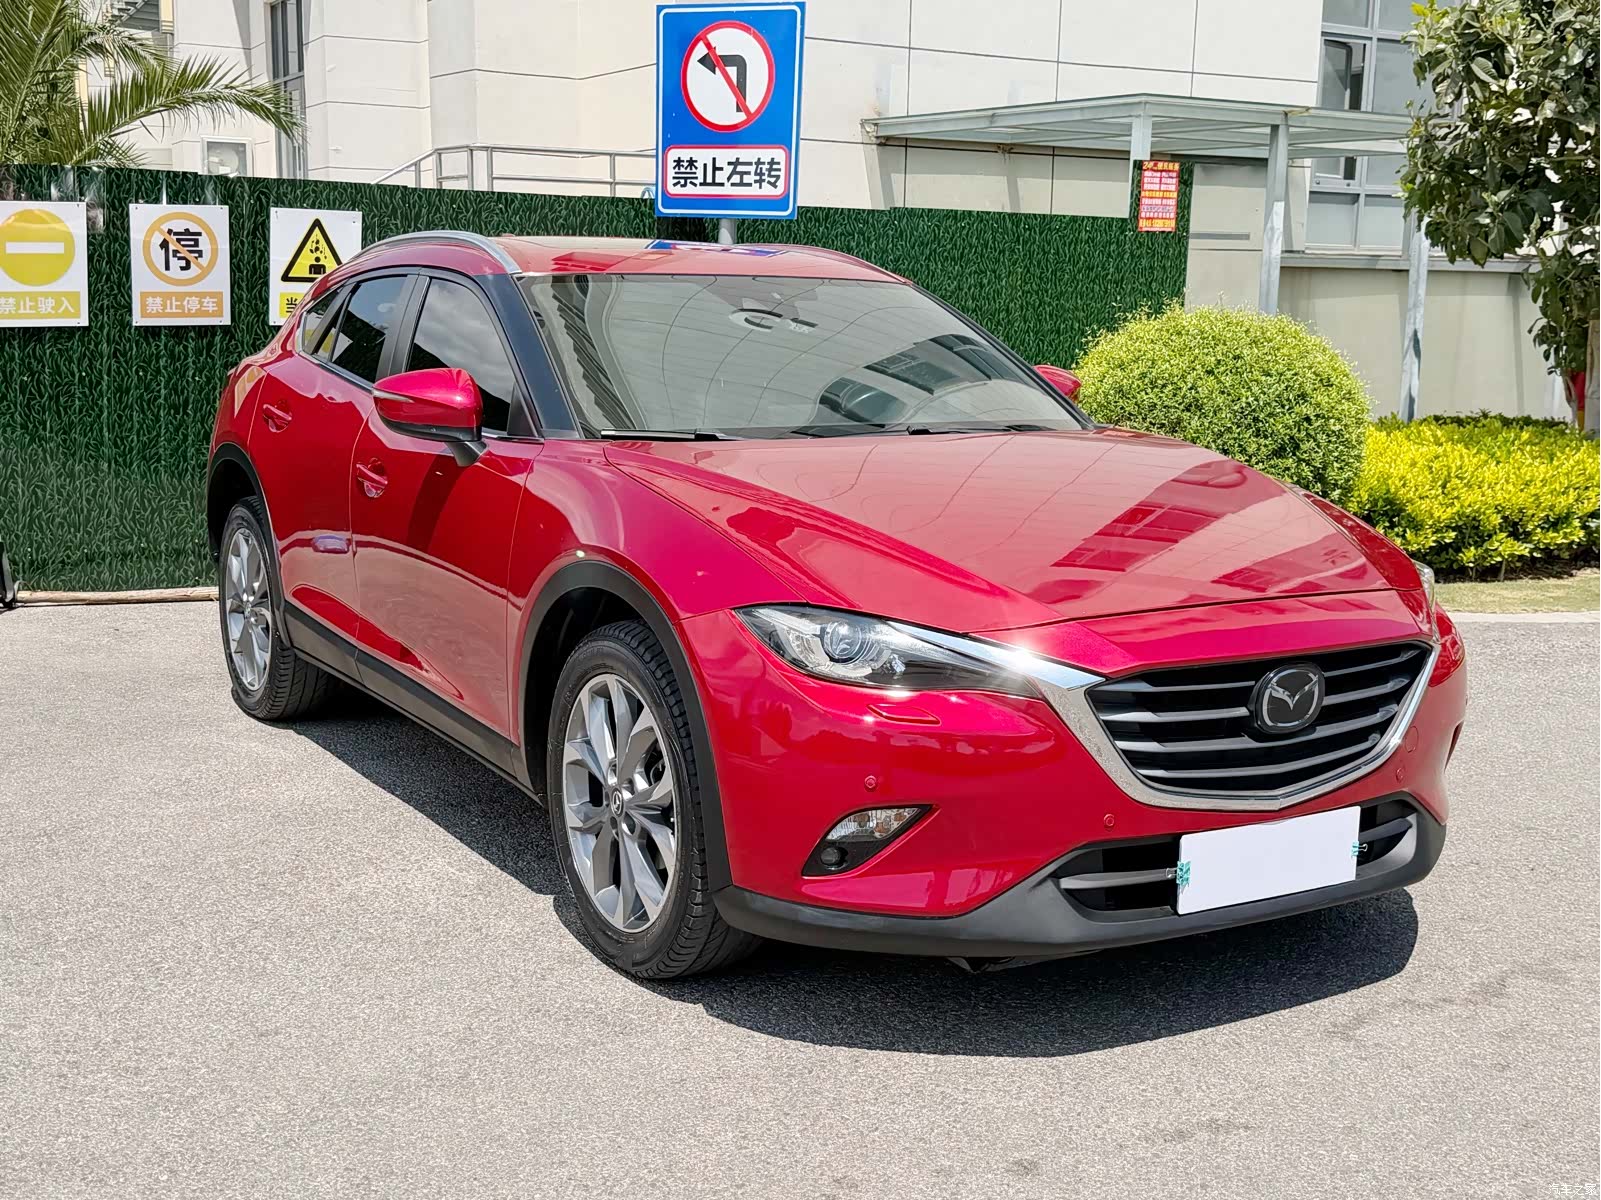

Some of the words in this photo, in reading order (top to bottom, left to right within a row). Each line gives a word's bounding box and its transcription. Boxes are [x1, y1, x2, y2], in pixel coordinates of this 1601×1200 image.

[672, 156, 782, 190] 禁止左转
[159, 227, 203, 271] 停
[0, 296, 75, 314] 禁止驶入
[146, 296, 218, 314] 禁止停车
[285, 297, 298, 313] 当
